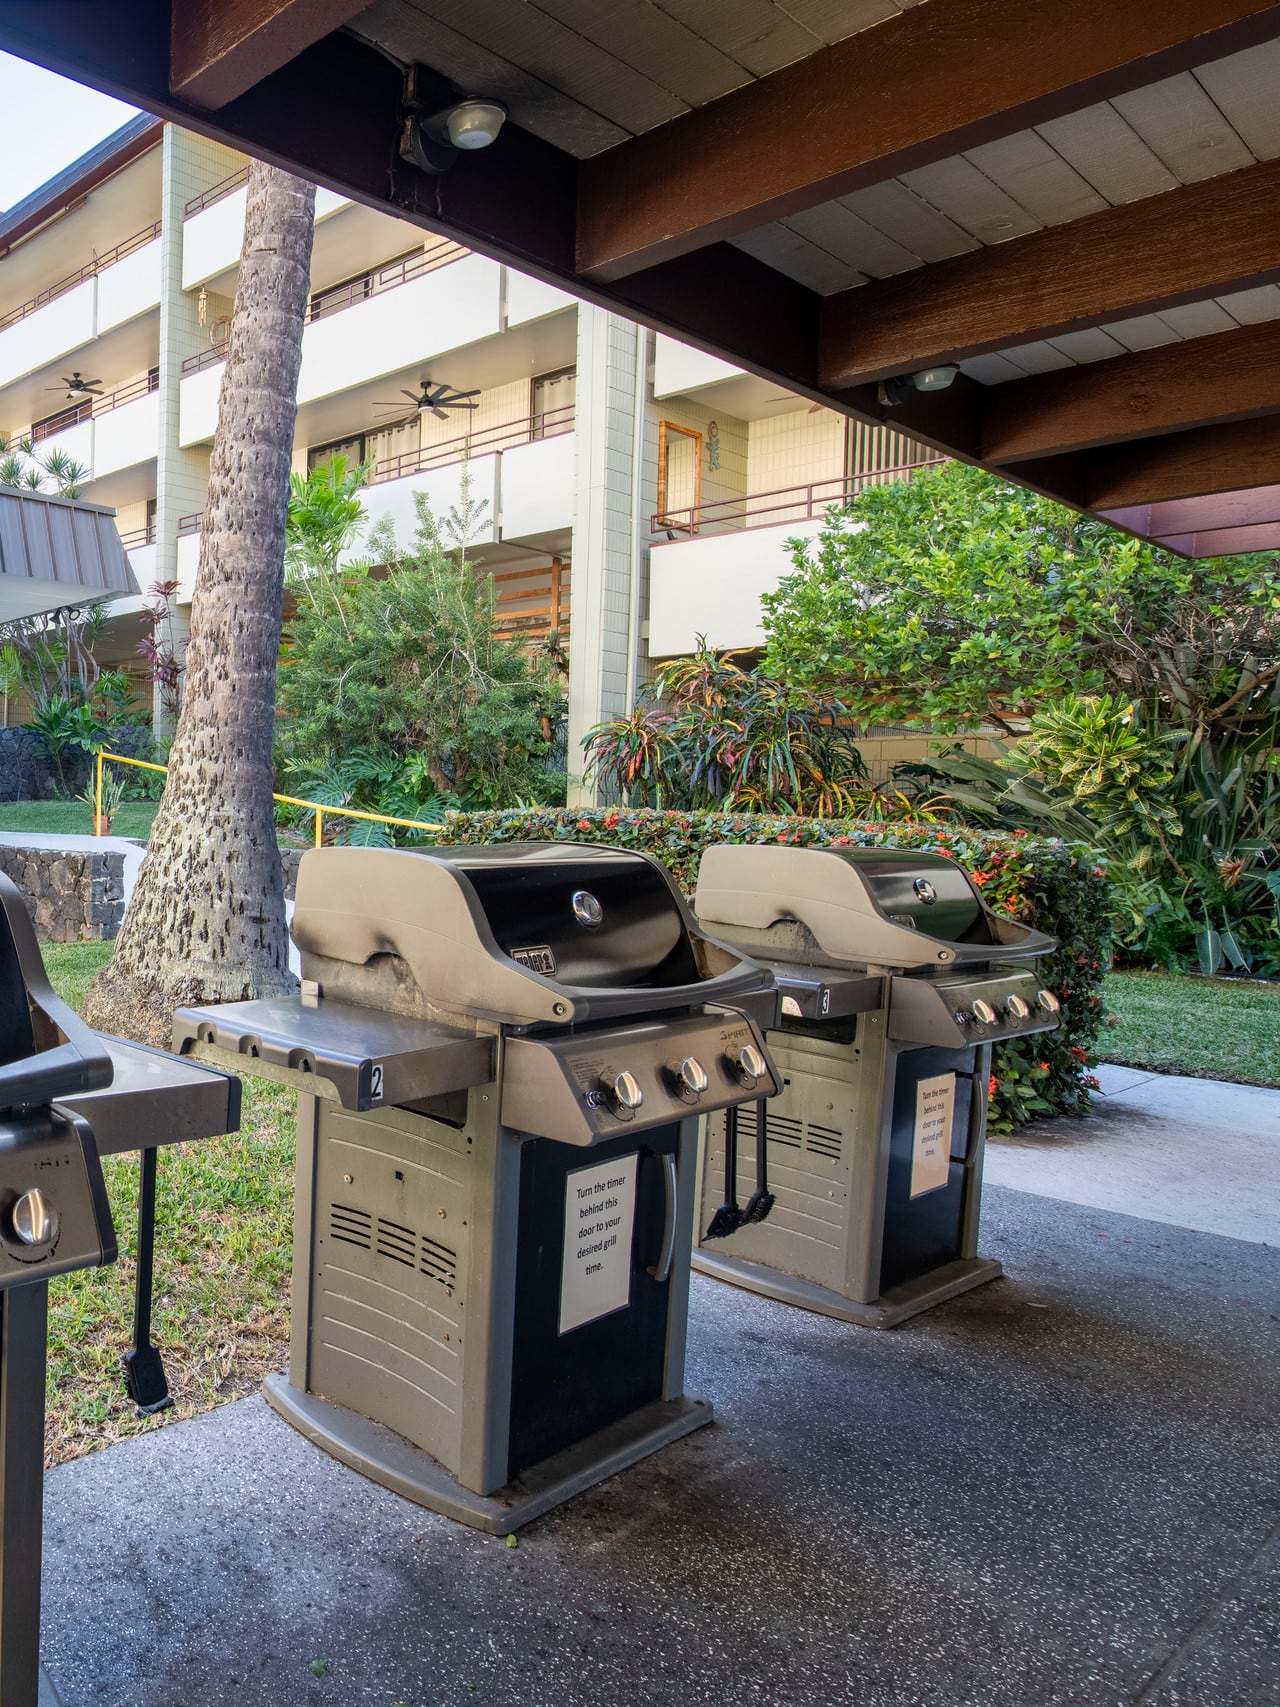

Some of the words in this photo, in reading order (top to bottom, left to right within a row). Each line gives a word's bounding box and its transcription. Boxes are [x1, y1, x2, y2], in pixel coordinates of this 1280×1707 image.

[822, 991, 829, 1012] 3
[371, 1066, 382, 1098] 2
[922, 1092, 931, 1100] Turn
[577, 1188, 592, 1199] Turn
[594, 1182, 605, 1193] the
[607, 1176, 626, 1189] timer
[579, 1202, 604, 1218] behind
[605, 1197, 618, 1209] this
[578, 1226, 595, 1239] door
[596, 1222, 604, 1232] to
[605, 1216, 621, 1231] your
[577, 1241, 602, 1259] desired
[603, 1235, 617, 1251] grill
[585, 1261, 604, 1275] time.
